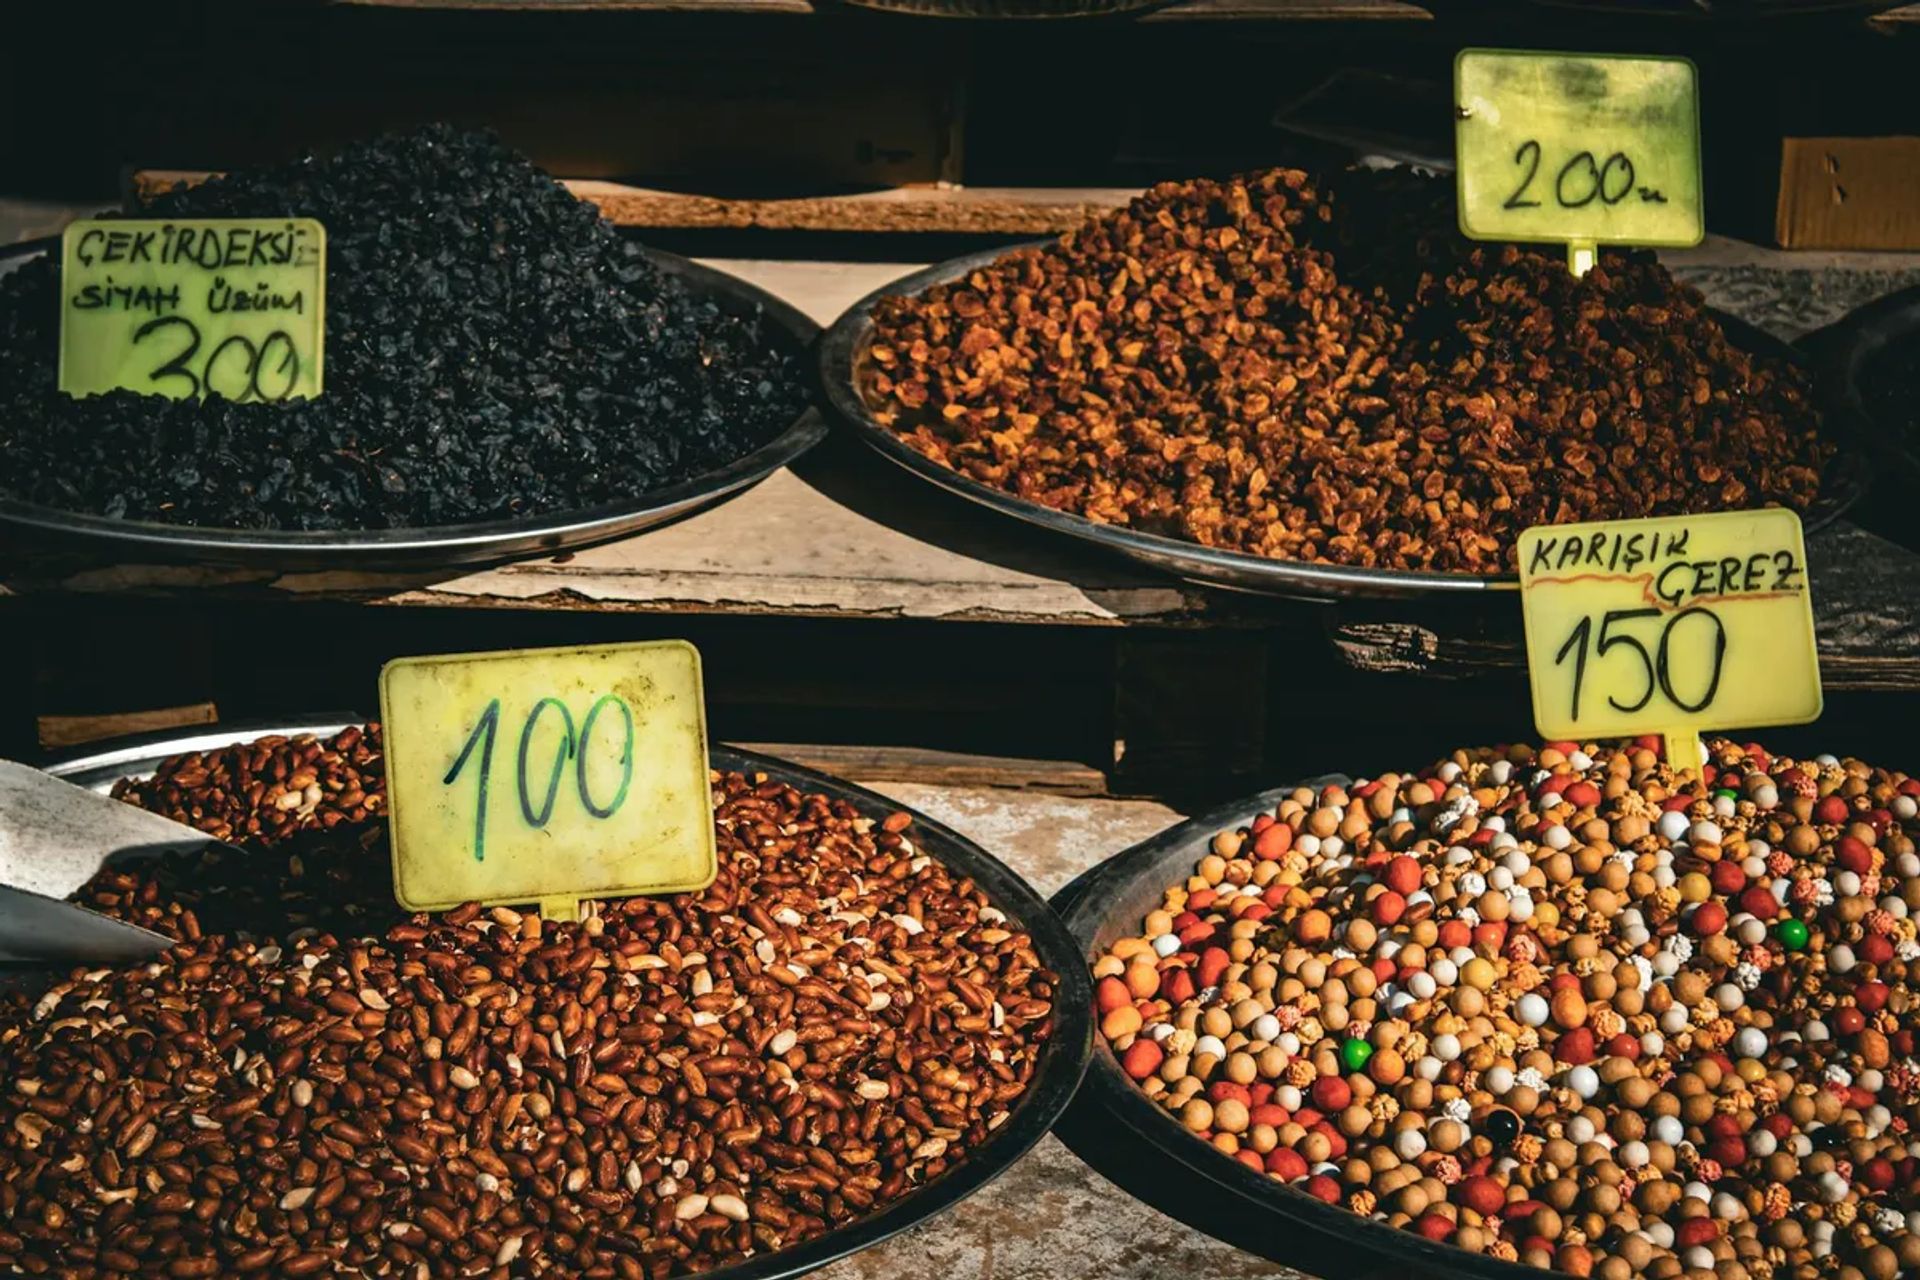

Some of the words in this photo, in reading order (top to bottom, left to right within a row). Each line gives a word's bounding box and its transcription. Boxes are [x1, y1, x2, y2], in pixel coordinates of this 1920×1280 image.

[72, 276, 180, 316] SİYAH
[133, 316, 299, 402] 300
[1529, 528, 1690, 576] KARIŞIK
[1656, 550, 1804, 607] ÇEREZ
[1555, 607, 1727, 722] 150
[443, 694, 634, 862] 100
